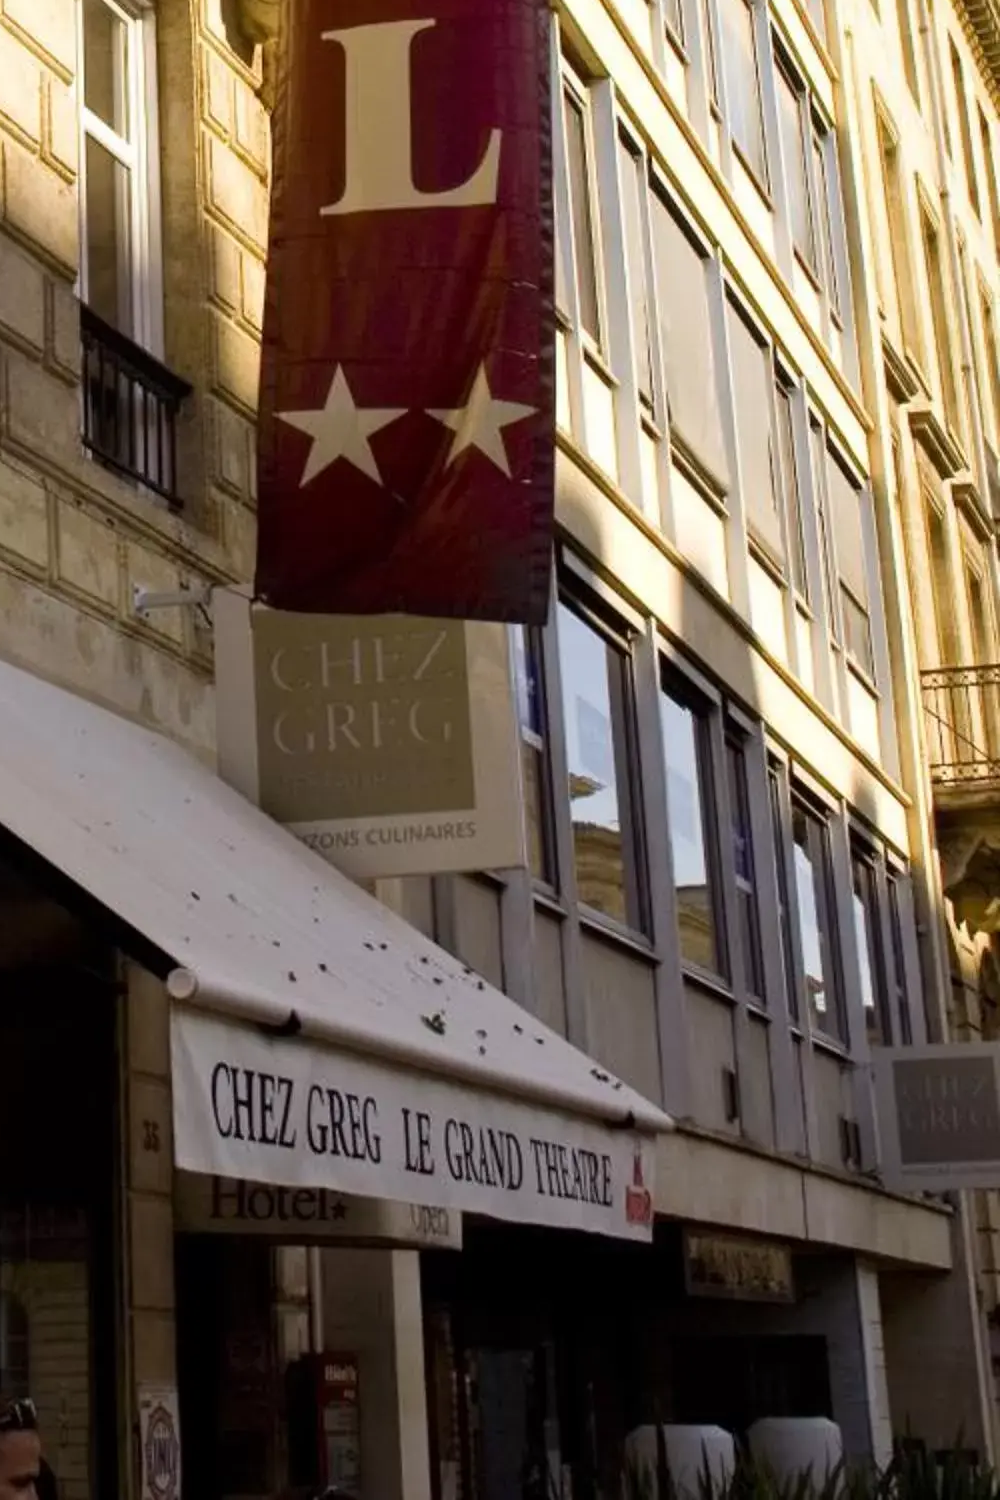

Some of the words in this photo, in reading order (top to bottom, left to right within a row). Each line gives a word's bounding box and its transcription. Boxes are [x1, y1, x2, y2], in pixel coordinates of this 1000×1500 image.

[271, 630, 453, 692] CHEZ
[273, 699, 452, 755] GREG
[365, 822, 477, 846] CULINAIRES
[212, 1062, 297, 1148] CHEZ
[307, 1085, 381, 1163] GREG
[402, 1108, 434, 1175] LE
[444, 1119, 523, 1190] GRAND
[529, 1138, 613, 1207] THEATRE
